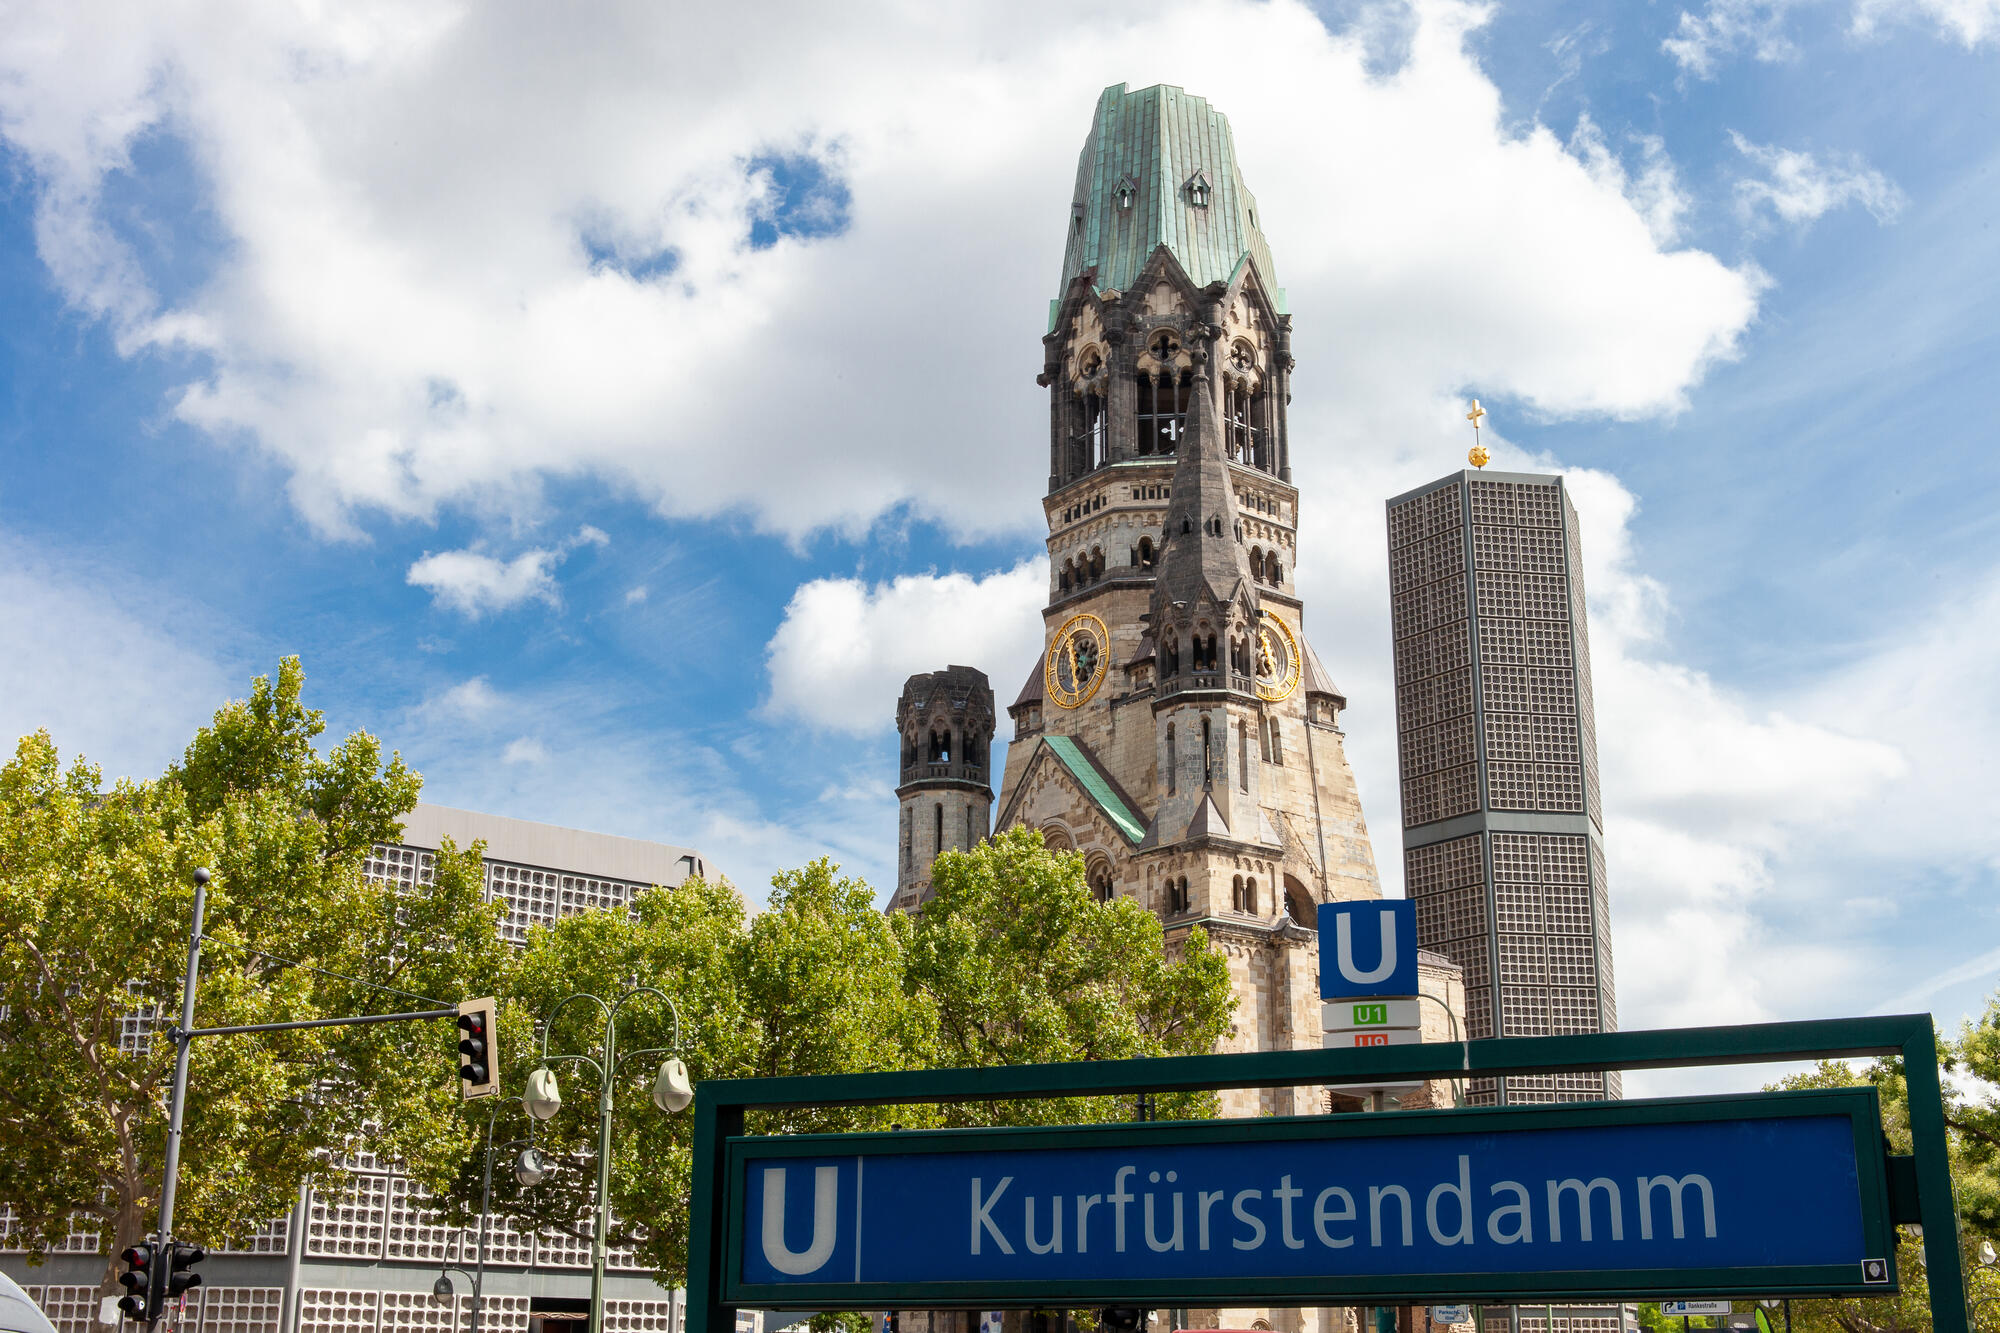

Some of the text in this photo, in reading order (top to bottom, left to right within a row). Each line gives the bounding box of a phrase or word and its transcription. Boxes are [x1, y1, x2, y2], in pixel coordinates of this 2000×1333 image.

[1336, 910, 1398, 984] U
[1357, 1007, 1382, 1022] U1
[762, 1155, 1718, 1276] U Kurfürstendamm
